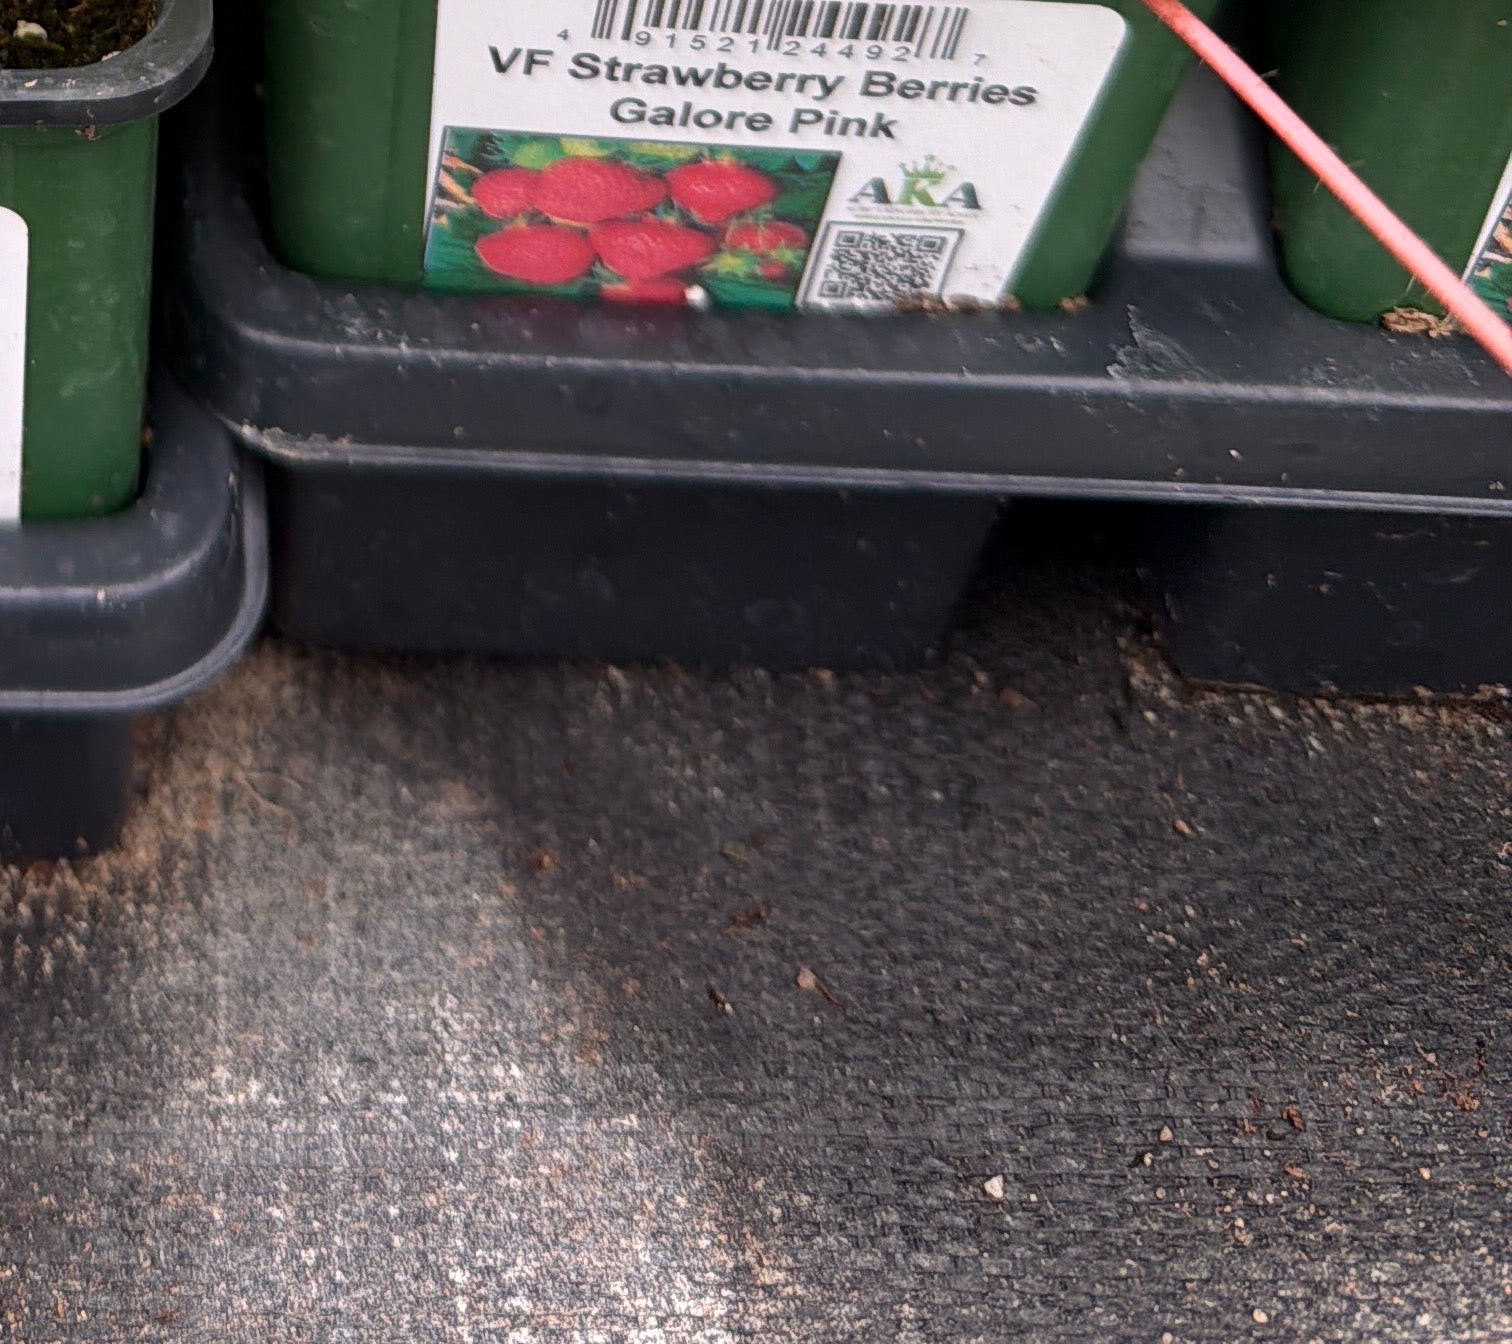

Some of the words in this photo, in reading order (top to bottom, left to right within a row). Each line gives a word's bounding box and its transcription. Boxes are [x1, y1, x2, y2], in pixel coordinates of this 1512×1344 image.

[634, 29, 762, 57] 91521
[783, 38, 912, 64] 24492
[487, 46, 555, 77] VF
[568, 51, 846, 101] Strawberry
[861, 70, 1038, 107] Berries
[609, 97, 775, 133] Galore
[788, 106, 898, 141] Pink
[847, 176, 983, 210] AKA
